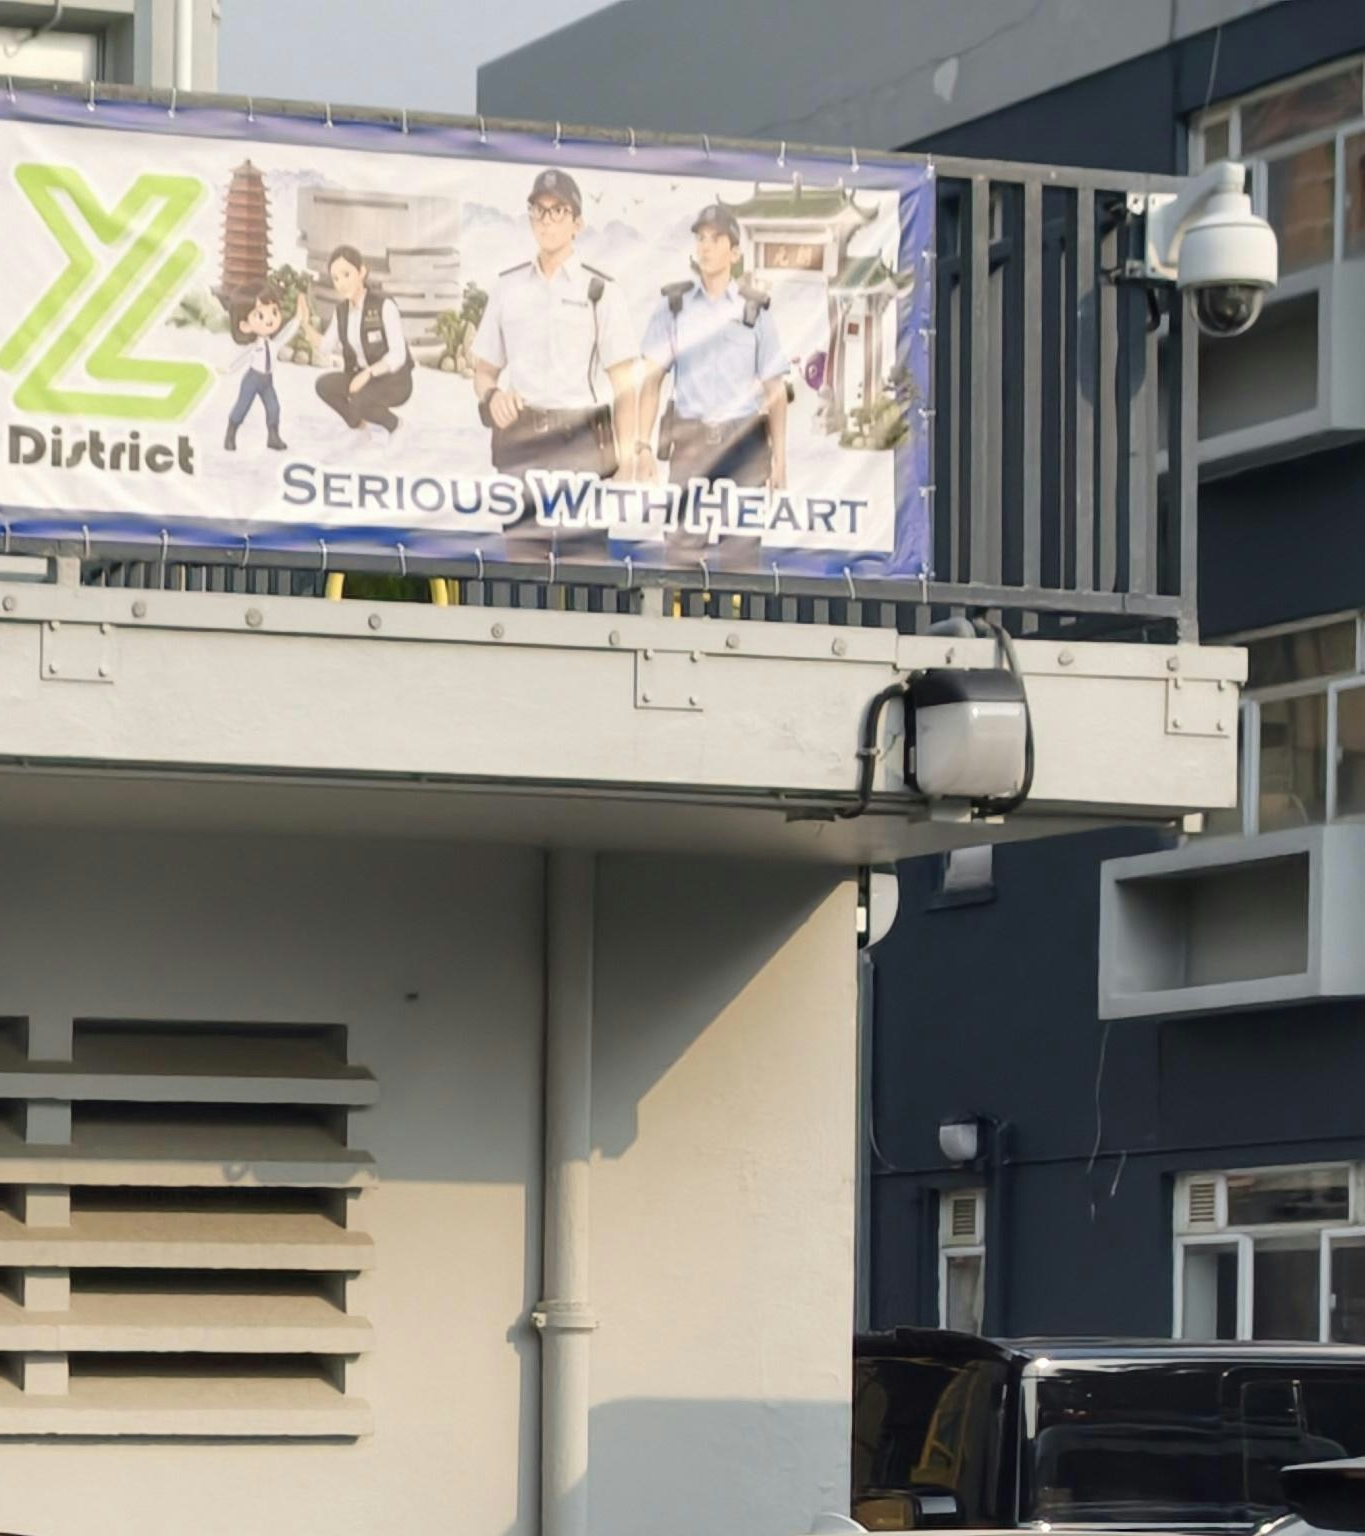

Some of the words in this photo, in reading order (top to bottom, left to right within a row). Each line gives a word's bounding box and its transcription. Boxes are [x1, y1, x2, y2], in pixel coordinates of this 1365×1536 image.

[8, 424, 195, 476] District
[282, 461, 519, 518] SERIOUS
[532, 477, 671, 524] WITH
[692, 484, 869, 534] HEART
